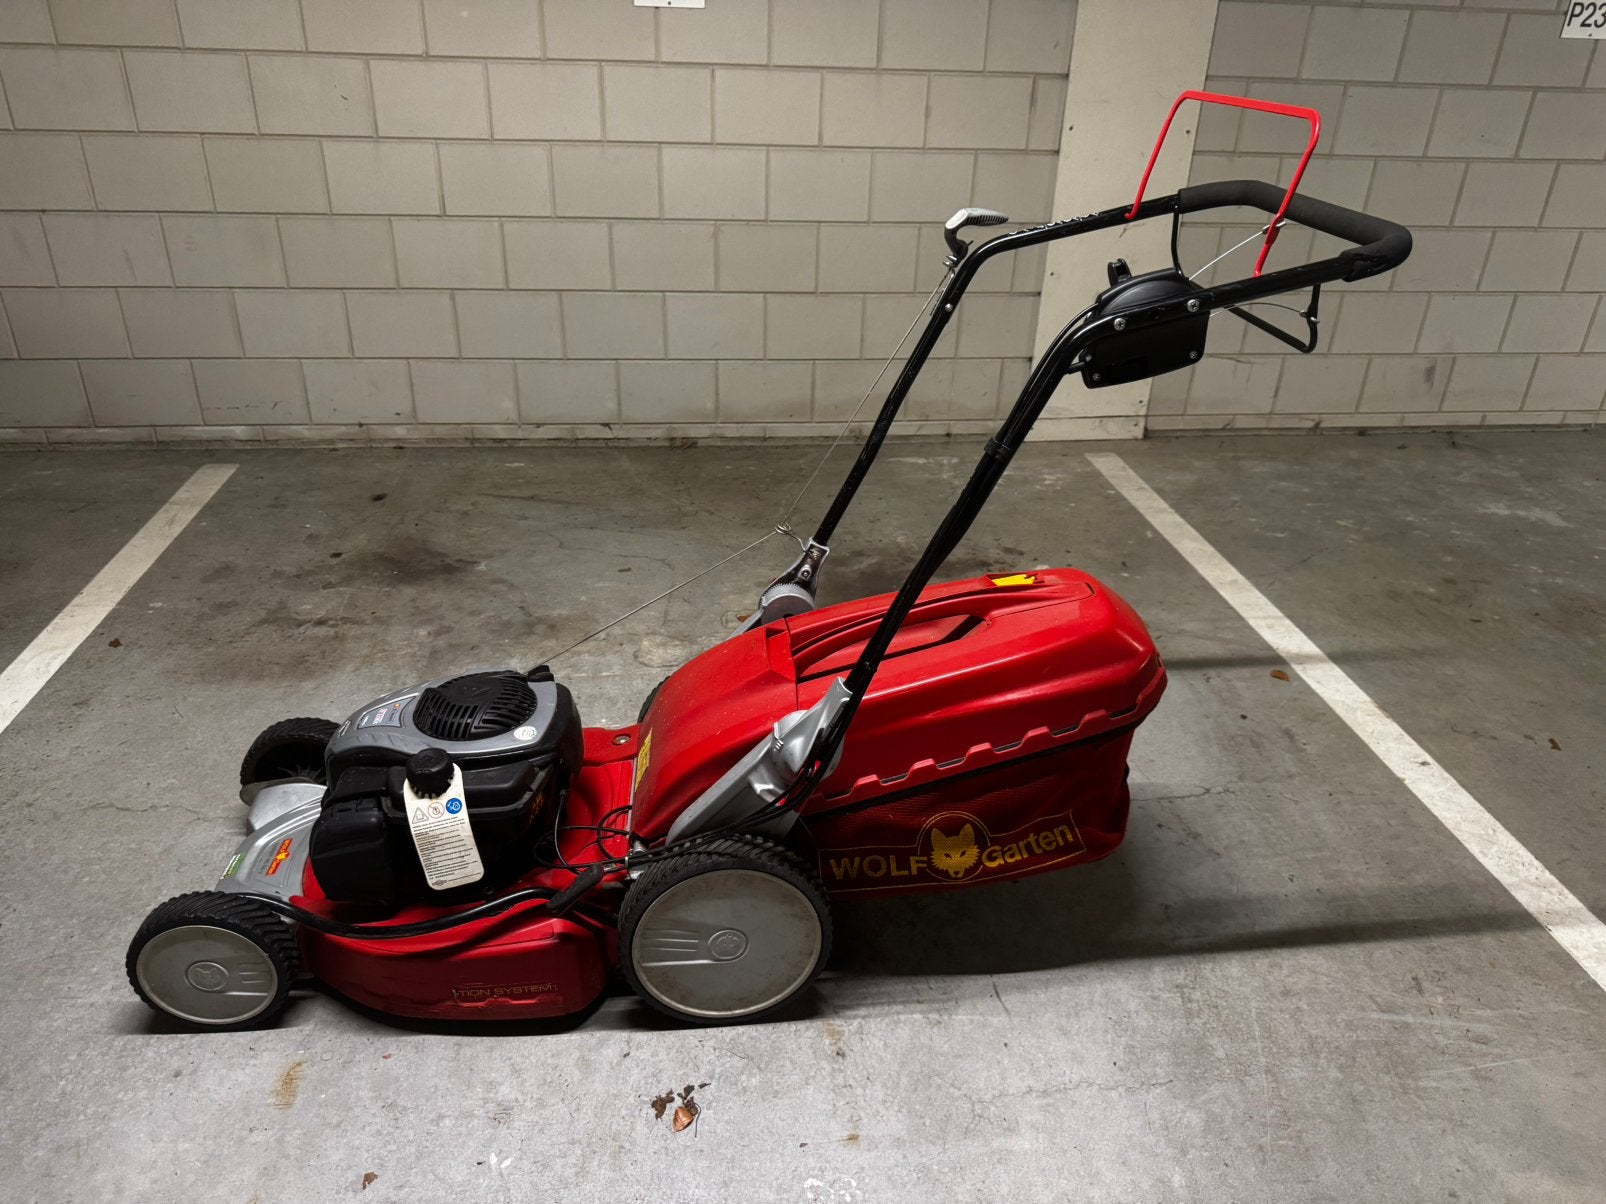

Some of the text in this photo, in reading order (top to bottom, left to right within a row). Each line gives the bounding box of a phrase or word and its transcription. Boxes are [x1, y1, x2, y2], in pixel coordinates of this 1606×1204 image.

[1567, 2, 1606, 28] P23
[829, 823, 1074, 880] WOLF Garten
